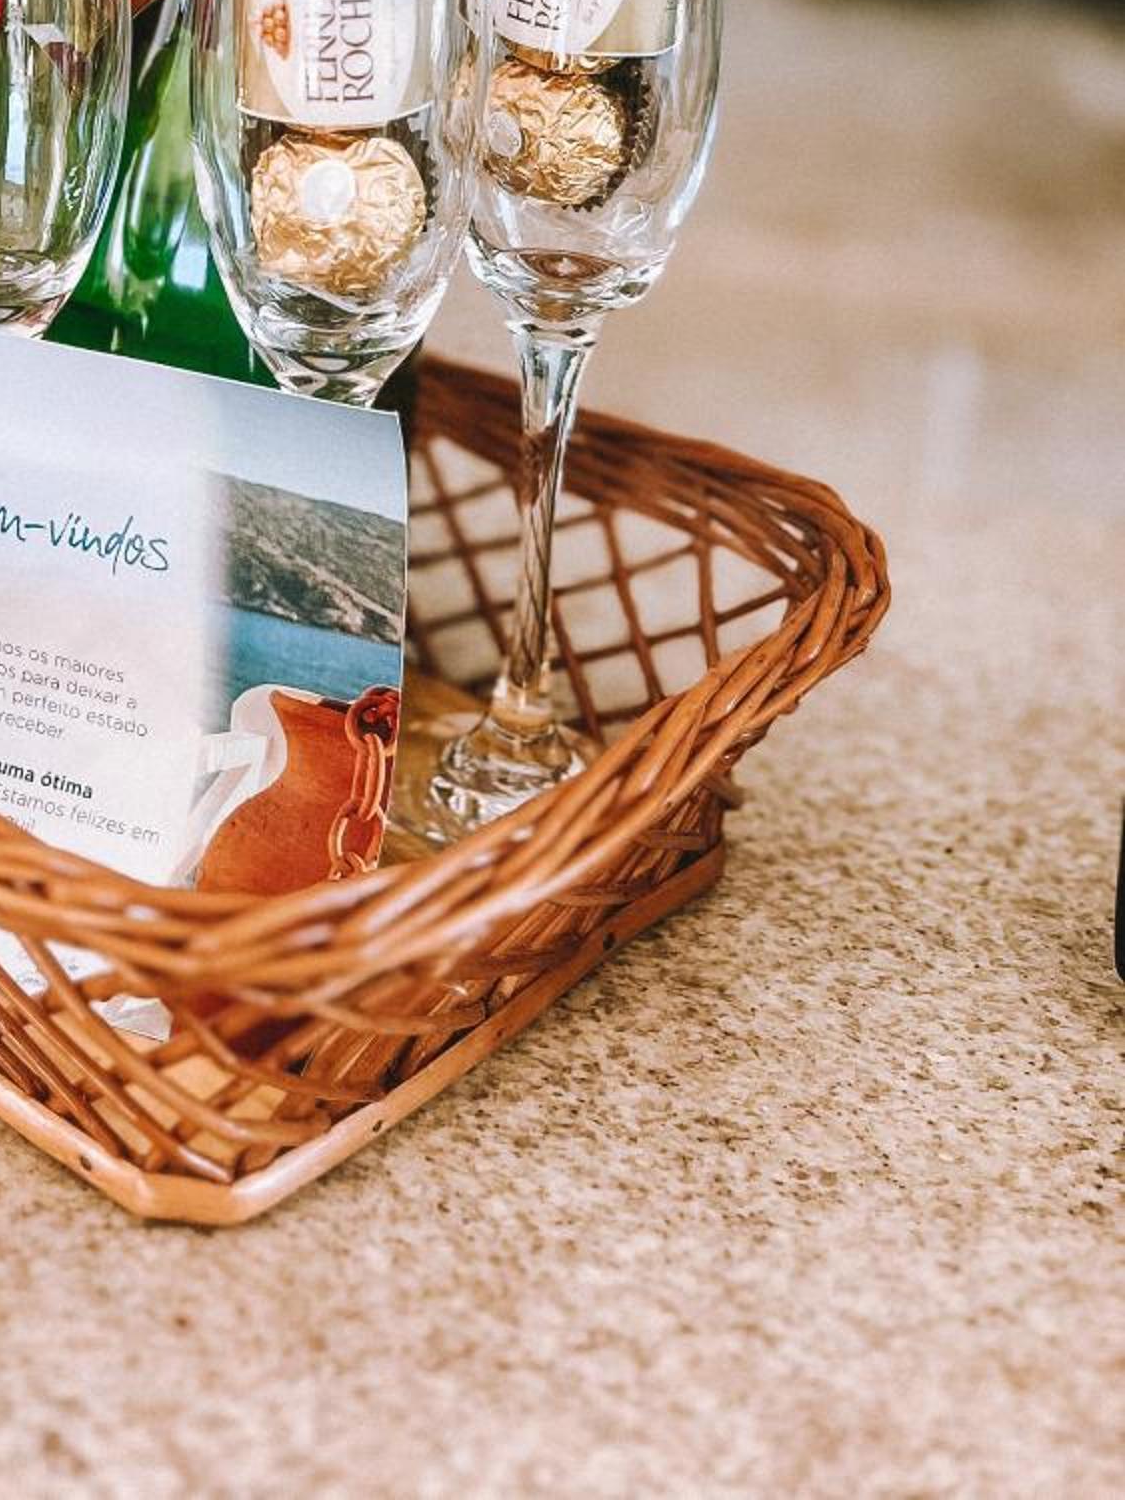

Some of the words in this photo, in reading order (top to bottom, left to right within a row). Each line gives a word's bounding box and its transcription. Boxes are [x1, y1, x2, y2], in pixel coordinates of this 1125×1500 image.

[28, 648, 49, 665] os
[54, 653, 125, 684] maiores
[21, 668, 61, 691] para
[66, 680, 122, 705] deixar
[126, 696, 138, 709] a
[11, 690, 82, 720] perfeito
[85, 708, 148, 738] estado
[39, 770, 94, 800] ótima
[69, 802, 127, 836] felizes
[130, 822, 161, 846] em
